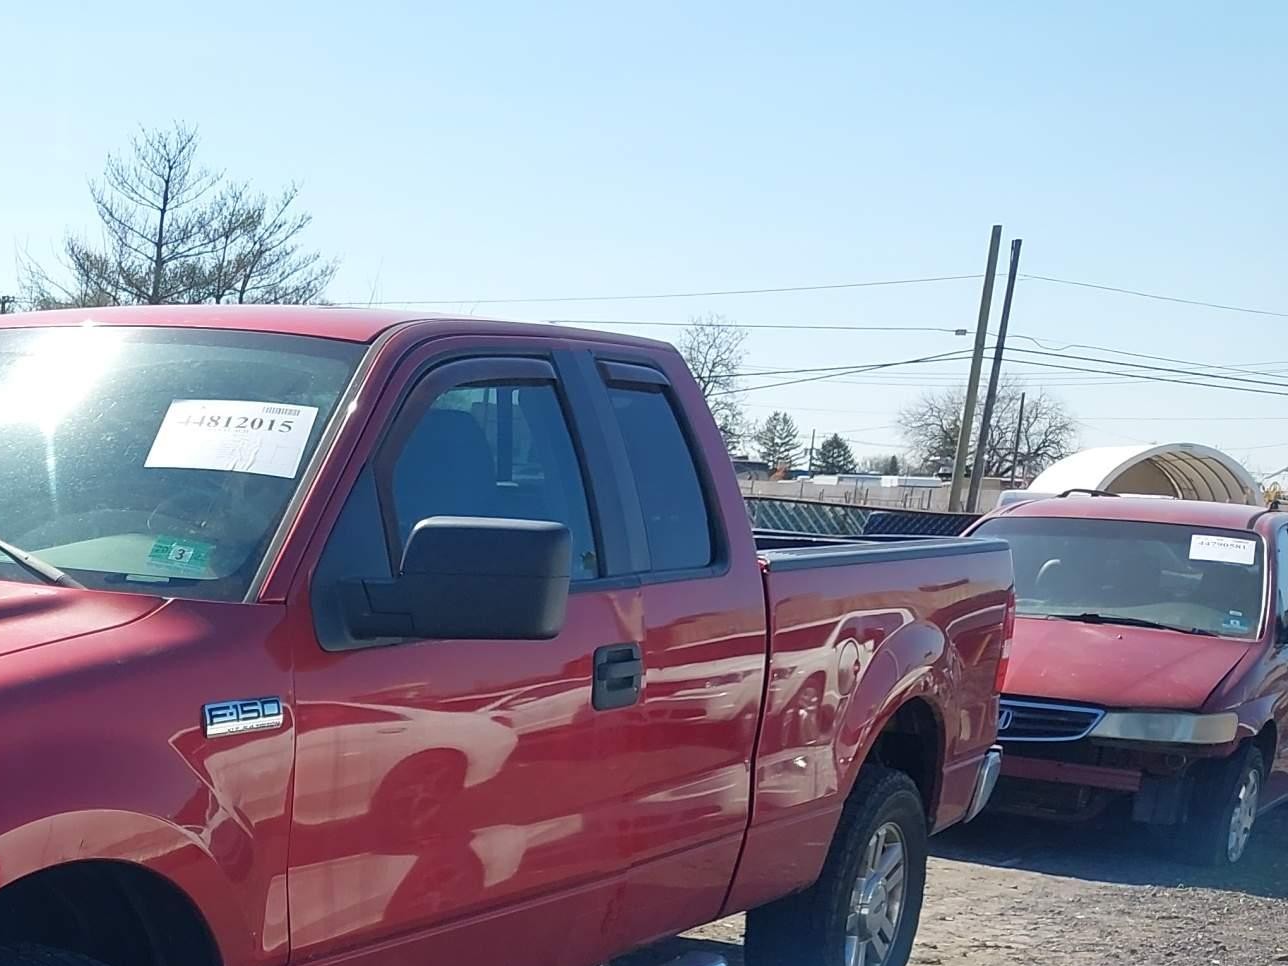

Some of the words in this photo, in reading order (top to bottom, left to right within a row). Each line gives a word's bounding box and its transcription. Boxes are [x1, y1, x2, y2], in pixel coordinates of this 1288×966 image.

[176, 415, 294, 433] 44812015
[174, 548, 185, 560] 3
[208, 699, 281, 726] F-150
